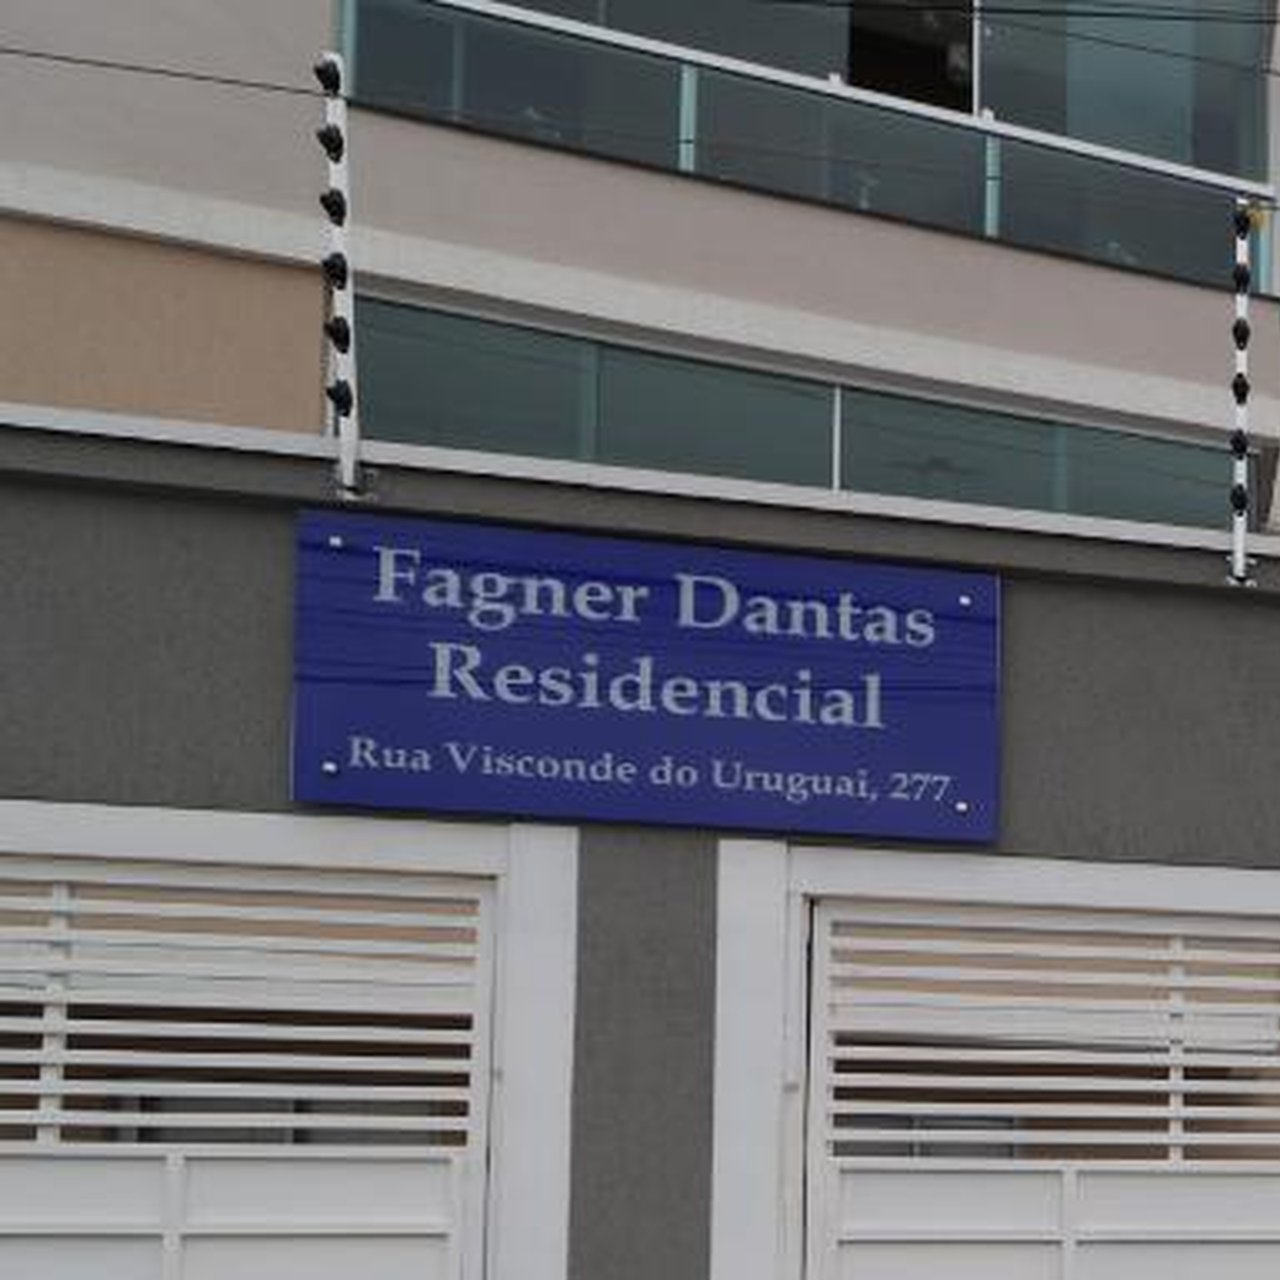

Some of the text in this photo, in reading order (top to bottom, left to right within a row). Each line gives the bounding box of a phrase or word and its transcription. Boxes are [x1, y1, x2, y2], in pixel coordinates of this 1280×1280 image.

[372, 545, 936, 648] Fagner Dantas
[426, 640, 886, 729] Residencial
[349, 736, 952, 804] Rua Visconde do Uruguai, 277
